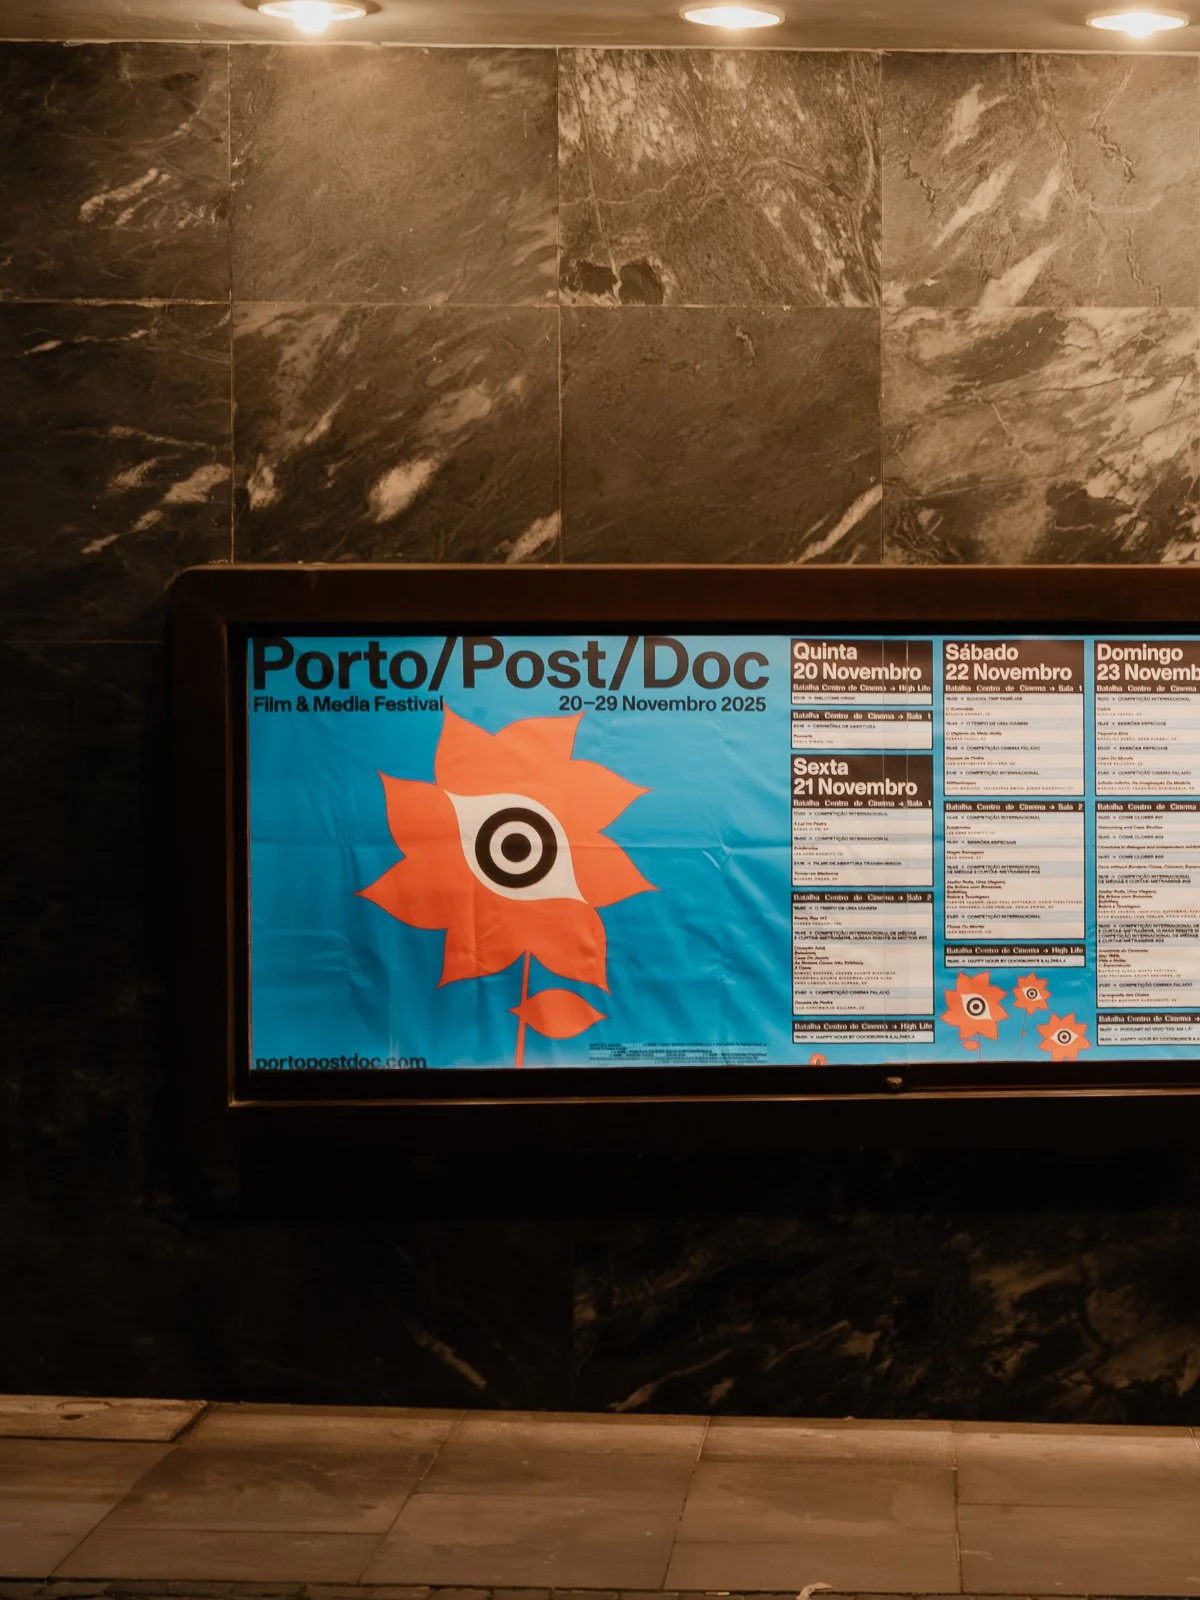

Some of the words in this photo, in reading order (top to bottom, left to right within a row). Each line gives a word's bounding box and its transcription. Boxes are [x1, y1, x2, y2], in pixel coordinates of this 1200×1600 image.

[793, 642, 857, 660] Quinta
[945, 642, 1019, 661] Sábado
[1097, 643, 1183, 664] Domingo
[253, 636, 770, 692] Porto/Post/Doc
[793, 662, 818, 681] 20
[823, 662, 922, 681] Novembro
[945, 663, 969, 681] 22
[973, 663, 1072, 681] Novembro
[1097, 664, 1120, 681] 23
[793, 684, 819, 693] Batalha
[822, 684, 845, 693] Centro
[848, 684, 857, 693] de
[860, 684, 887, 693] Cinema
[899, 684, 915, 693] High
[918, 684, 931, 693] Life
[253, 695, 292, 712] Film
[296, 696, 310, 712] &
[313, 695, 370, 712] Media
[374, 695, 444, 712] Festival
[622, 695, 717, 712] Novembro
[720, 696, 767, 712] 2025
[793, 757, 848, 775] Sexta
[793, 778, 813, 796] 21
[818, 778, 918, 796] Novembro
[793, 799, 819, 807] Batalha
[825, 799, 848, 807] Centro
[854, 799, 863, 807] de
[868, 799, 894, 807] Cinema
[907, 799, 922, 807] Sala
[946, 803, 972, 811] Batalha
[977, 803, 1000, 811] Centro
[1006, 803, 1014, 811] de
[1019, 803, 1046, 811] Cinema
[1058, 803, 1073, 811] Sala
[1078, 803, 1083, 811] 2
[1098, 803, 1123, 811] Batalha
[1128, 803, 1151, 811] Centro
[1156, 803, 1165, 811] de
[1170, 803, 1196, 811] Cinema
[947, 947, 972, 955] Batalha
[975, 947, 998, 955] Centro
[1002, 947, 1010, 955] de
[1013, 947, 1039, 955] Cinema
[1052, 947, 1068, 955] High
[1071, 947, 1083, 955] Life
[795, 1022, 820, 1030] Batalha
[824, 1022, 847, 1030] Centro
[850, 1022, 858, 1030] de
[862, 1022, 888, 1030] Cinema
[901, 1022, 917, 1030] High
[920, 1022, 932, 1030] Life
[256, 1053, 427, 1069] portopostdoc.com
